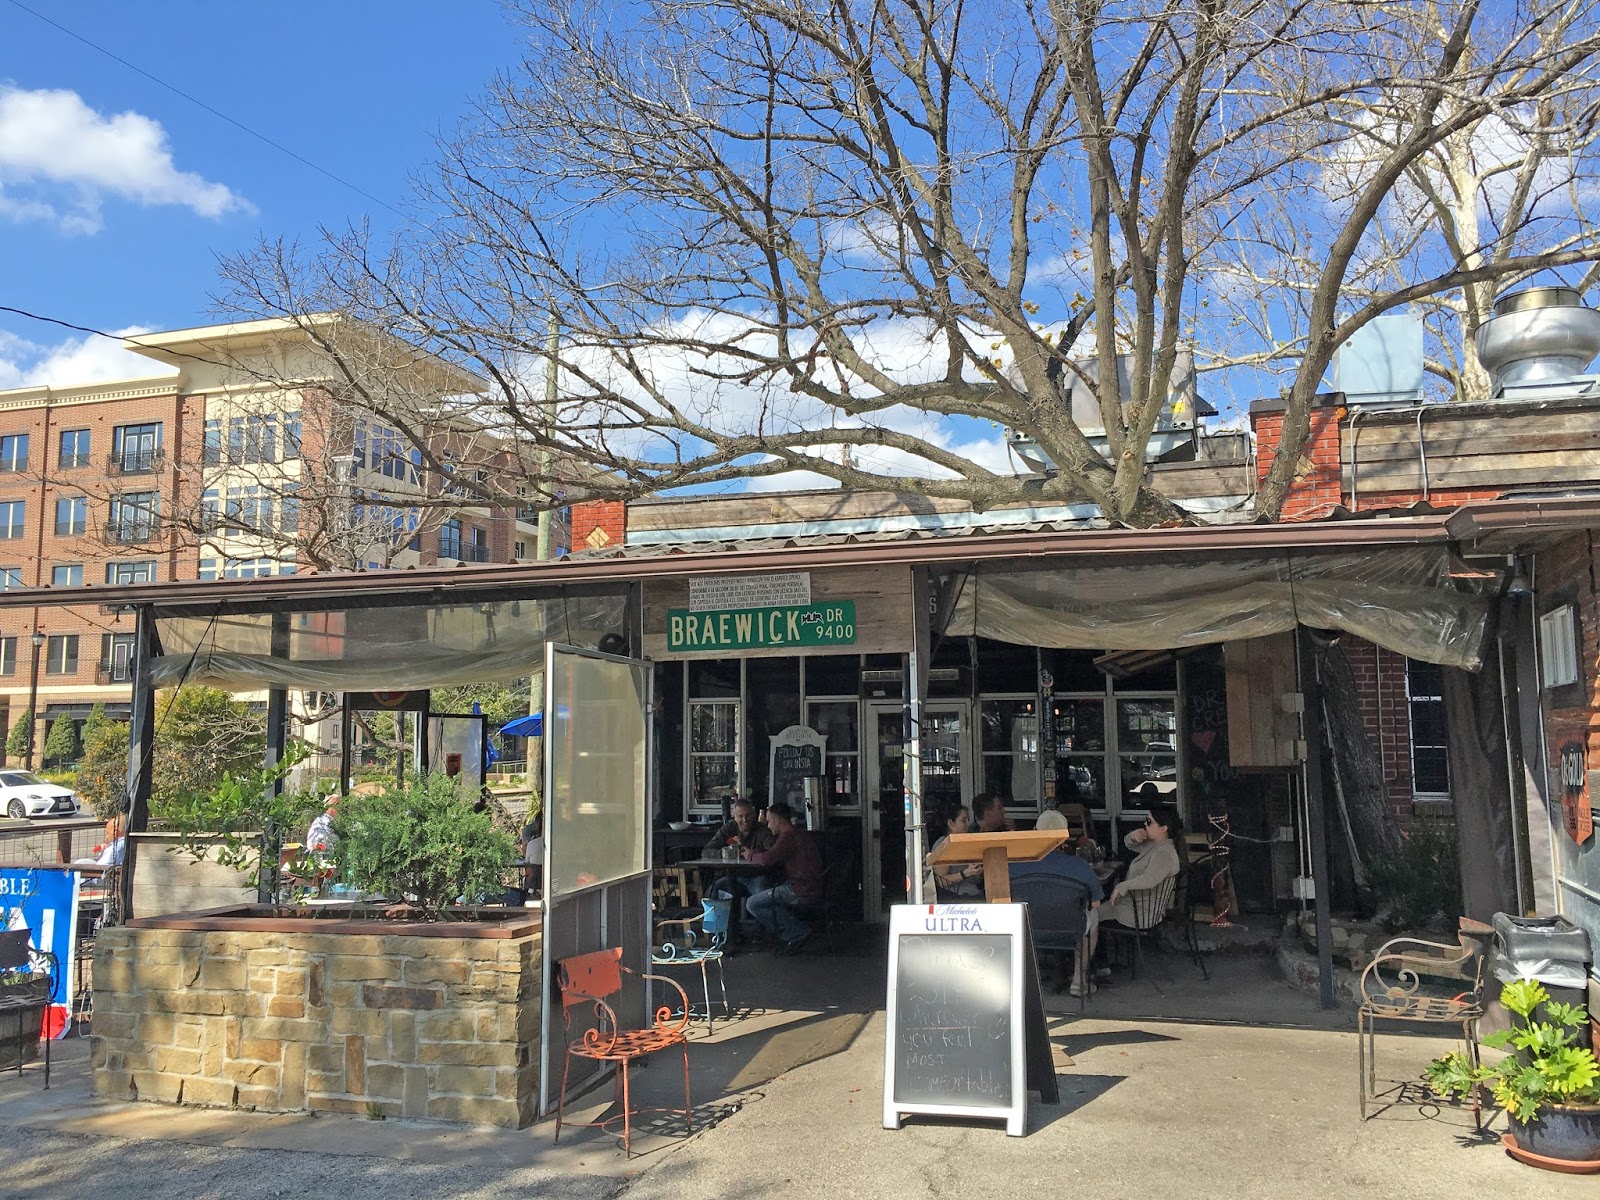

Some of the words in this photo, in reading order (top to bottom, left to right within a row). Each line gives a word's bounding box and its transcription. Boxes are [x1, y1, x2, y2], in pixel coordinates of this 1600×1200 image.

[671, 610, 800, 646] BRAEWICK
[826, 608, 843, 622] DR
[815, 624, 853, 639] 9400
[778, 747, 803, 759] FOLLOW
[805, 746, 814, 757] US
[936, 904, 978, 916] Michelob
[925, 917, 983, 932] ULTRA
